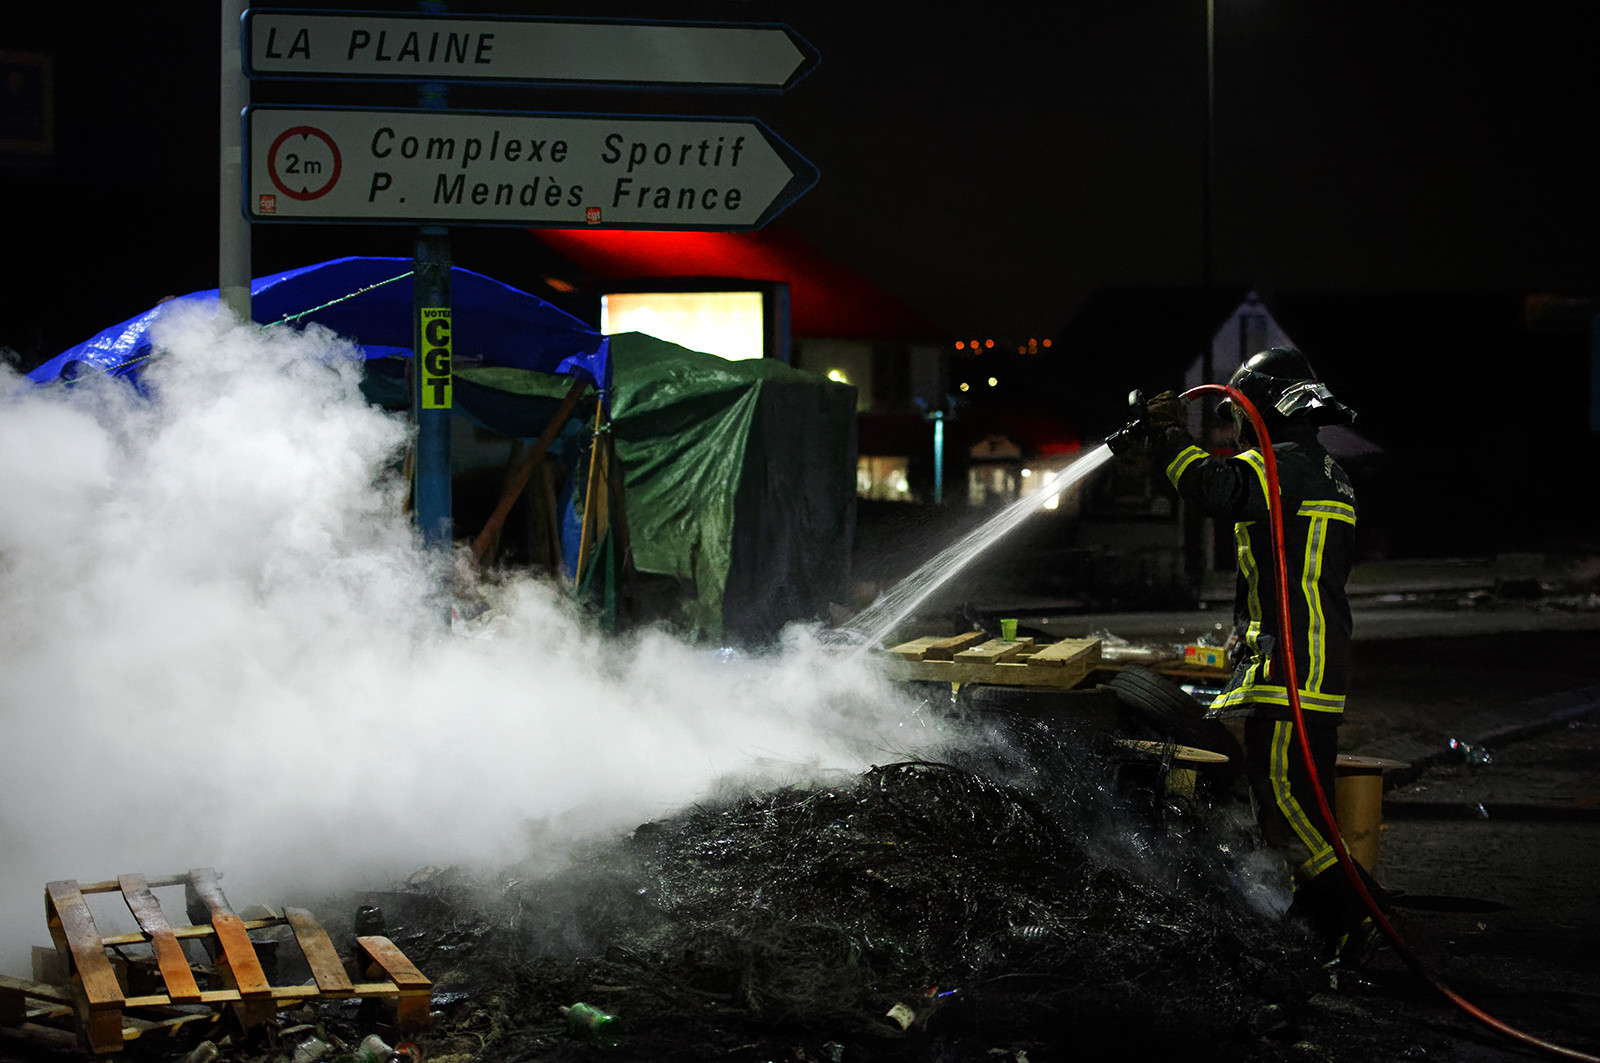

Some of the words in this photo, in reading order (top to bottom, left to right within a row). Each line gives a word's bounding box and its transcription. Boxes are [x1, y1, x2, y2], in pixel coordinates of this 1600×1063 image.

[265, 27, 311, 60] LA
[347, 30, 495, 64] PLAINE
[371, 127, 568, 169] Complexe
[601, 133, 746, 173] Sportif
[368, 172, 406, 203] P.
[433, 173, 584, 207] Mendès
[612, 178, 742, 211] France
[425, 318, 451, 405] CGT
